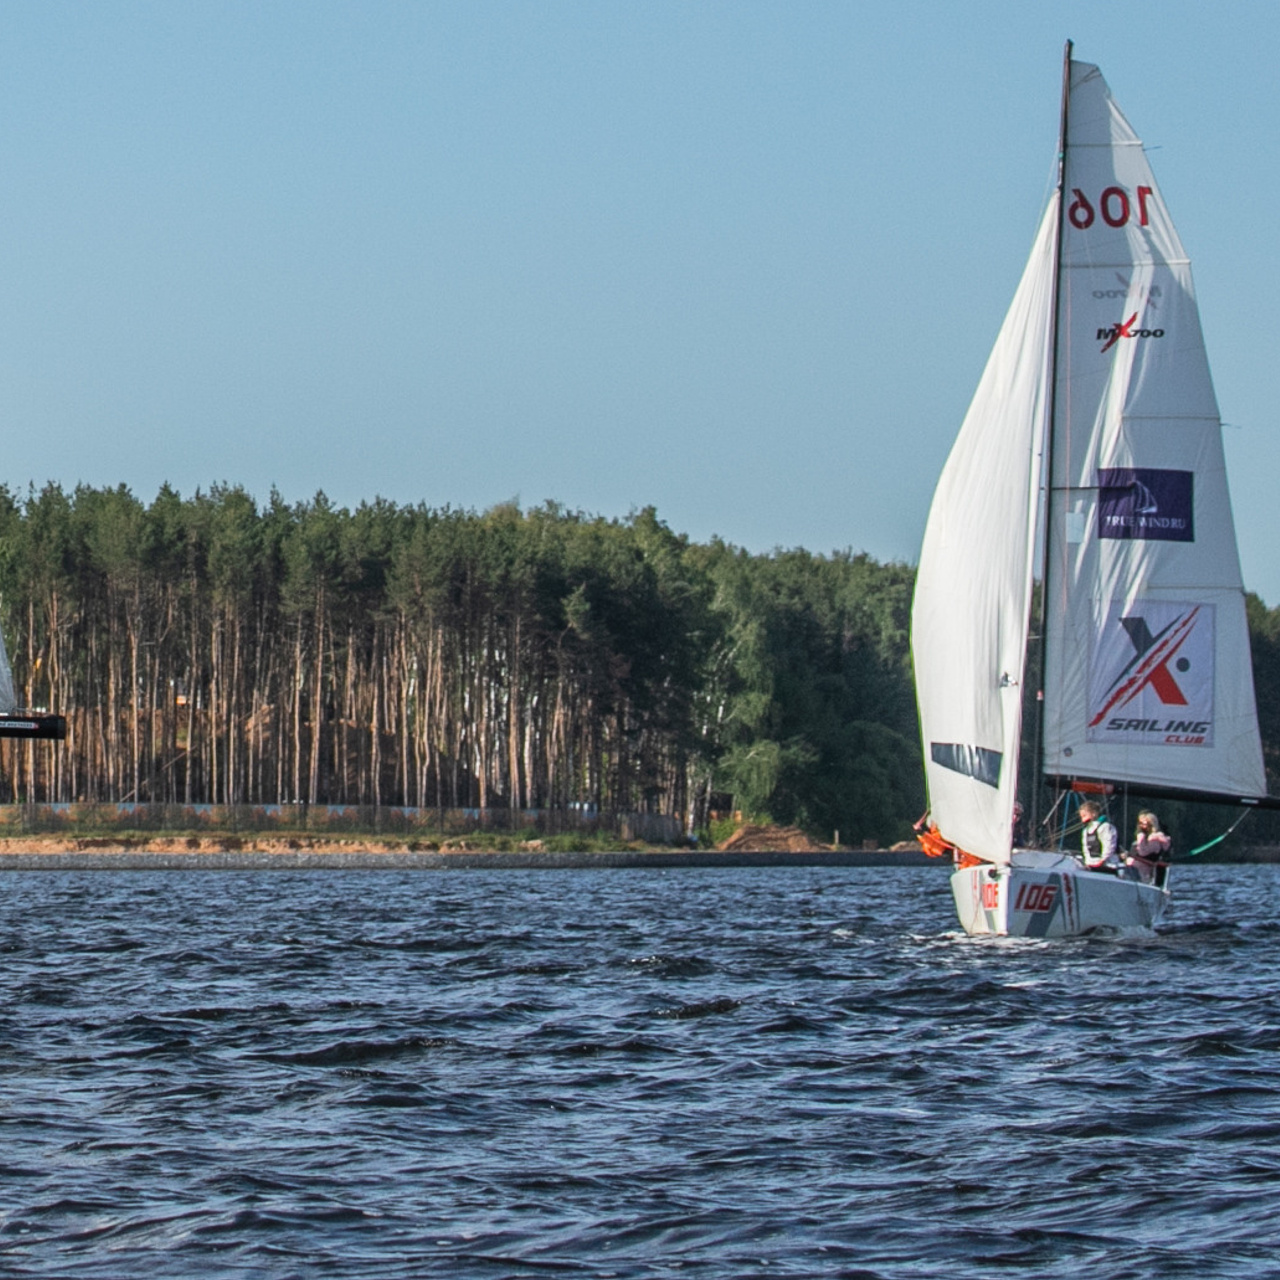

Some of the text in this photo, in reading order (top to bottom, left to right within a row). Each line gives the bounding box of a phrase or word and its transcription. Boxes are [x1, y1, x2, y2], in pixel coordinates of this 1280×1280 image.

[1096, 311, 1165, 354] MX700
[1105, 718, 1212, 734] SAILING
[1164, 734, 1205, 745] CLUB
[1014, 883, 1059, 912] 106
